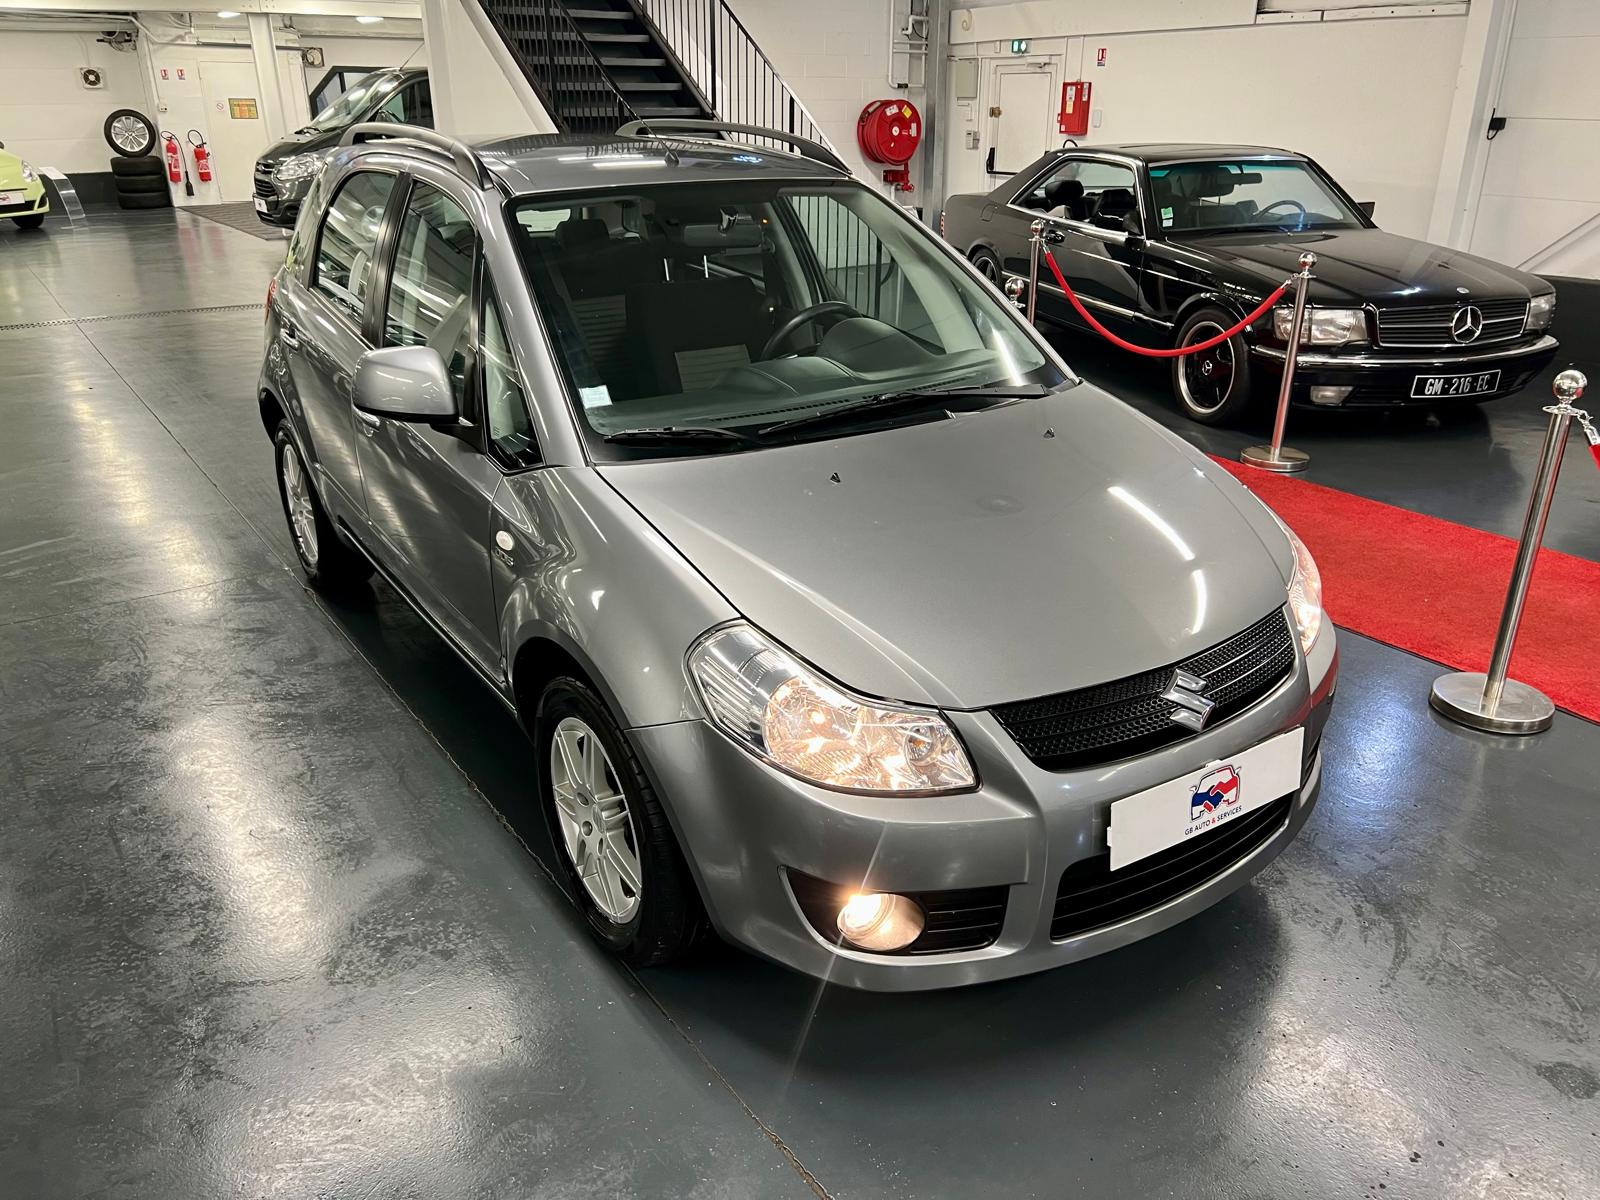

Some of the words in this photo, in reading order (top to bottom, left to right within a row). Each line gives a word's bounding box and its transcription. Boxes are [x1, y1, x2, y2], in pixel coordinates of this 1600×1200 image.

[1184, 827, 1194, 836] GB
[1194, 820, 1211, 832] AUTO
[1217, 805, 1242, 822] SERVICES
